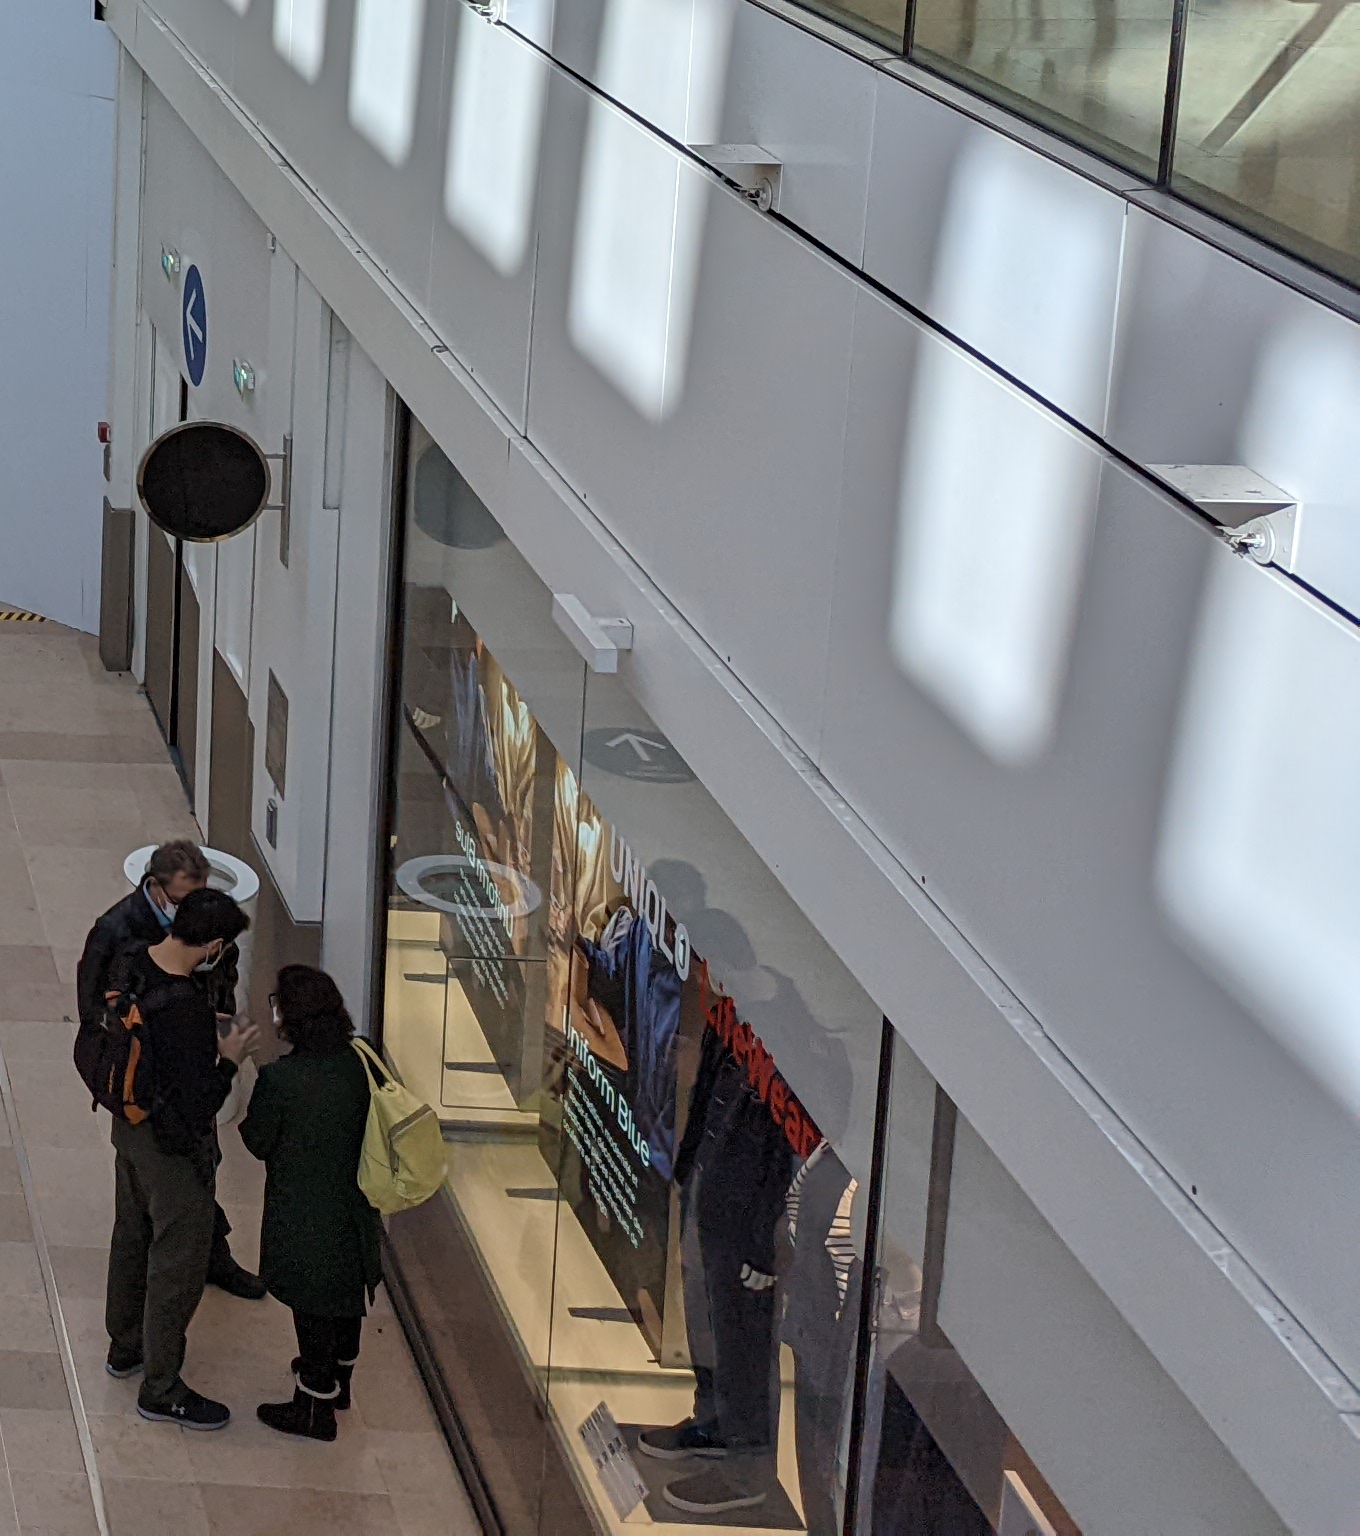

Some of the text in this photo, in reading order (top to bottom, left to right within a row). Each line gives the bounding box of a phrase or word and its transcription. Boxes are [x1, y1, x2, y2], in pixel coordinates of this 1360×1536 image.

[609, 823, 691, 982] UNIQLO
[562, 1004, 650, 1167] Uniform Blue
